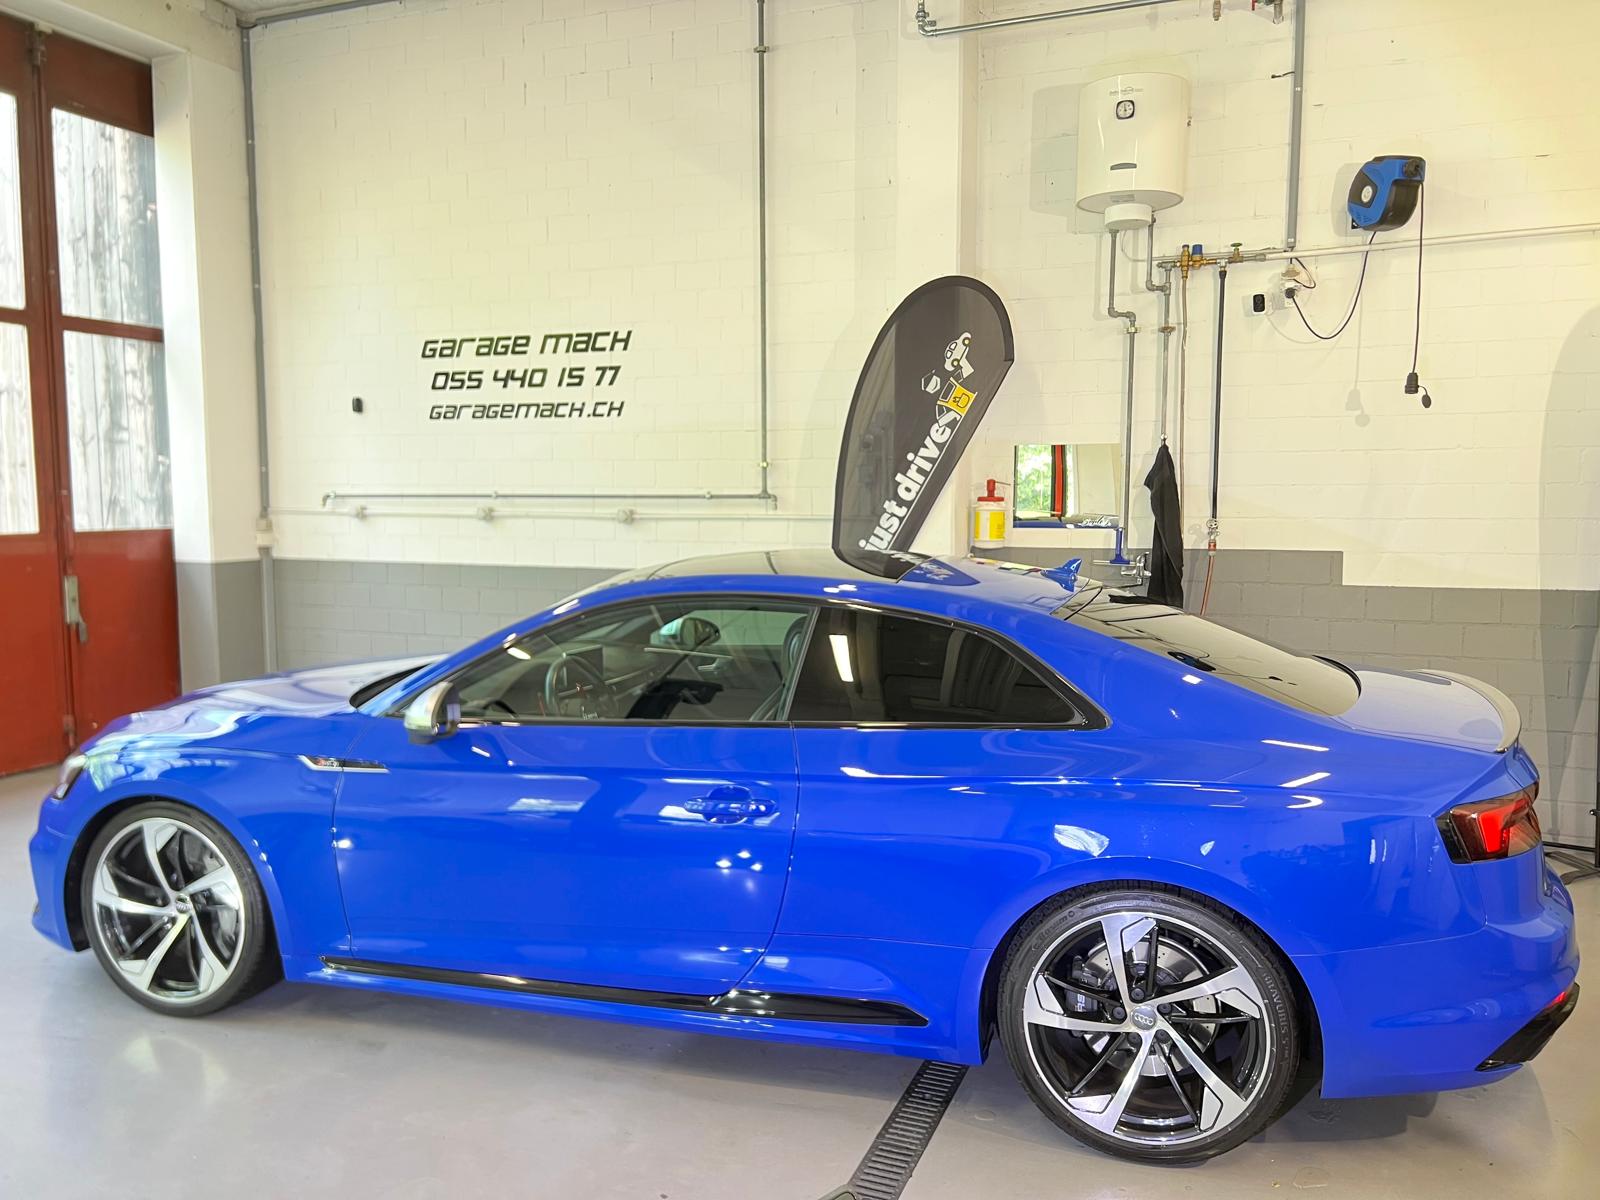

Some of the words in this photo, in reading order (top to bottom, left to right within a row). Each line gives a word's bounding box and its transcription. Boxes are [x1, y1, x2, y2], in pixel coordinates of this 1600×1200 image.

[431, 370, 484, 390] 055
[492, 367, 548, 388] 440
[557, 366, 586, 387] 15
[595, 365, 621, 386] 77
[858, 498, 907, 551] just
